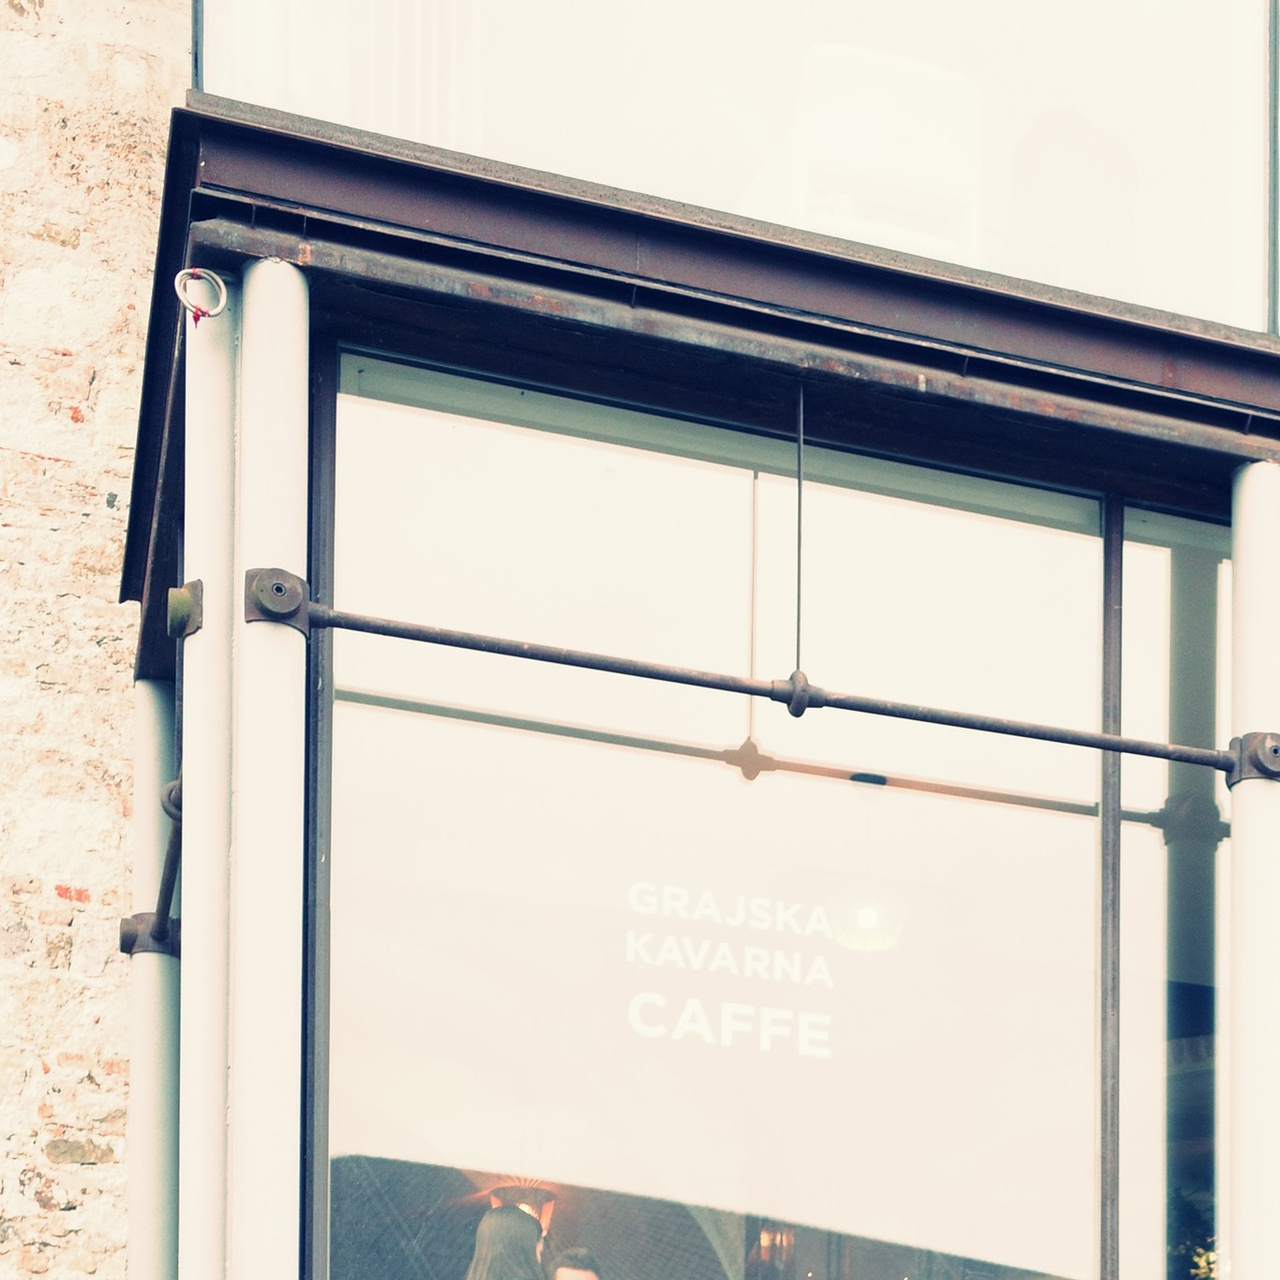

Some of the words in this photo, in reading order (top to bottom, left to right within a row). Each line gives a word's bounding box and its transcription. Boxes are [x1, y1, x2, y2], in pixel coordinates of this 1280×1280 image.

[627, 881, 835, 939] GRAJSKA
[625, 930, 835, 989] KAVARNA
[627, 991, 833, 1059] CAFFE
